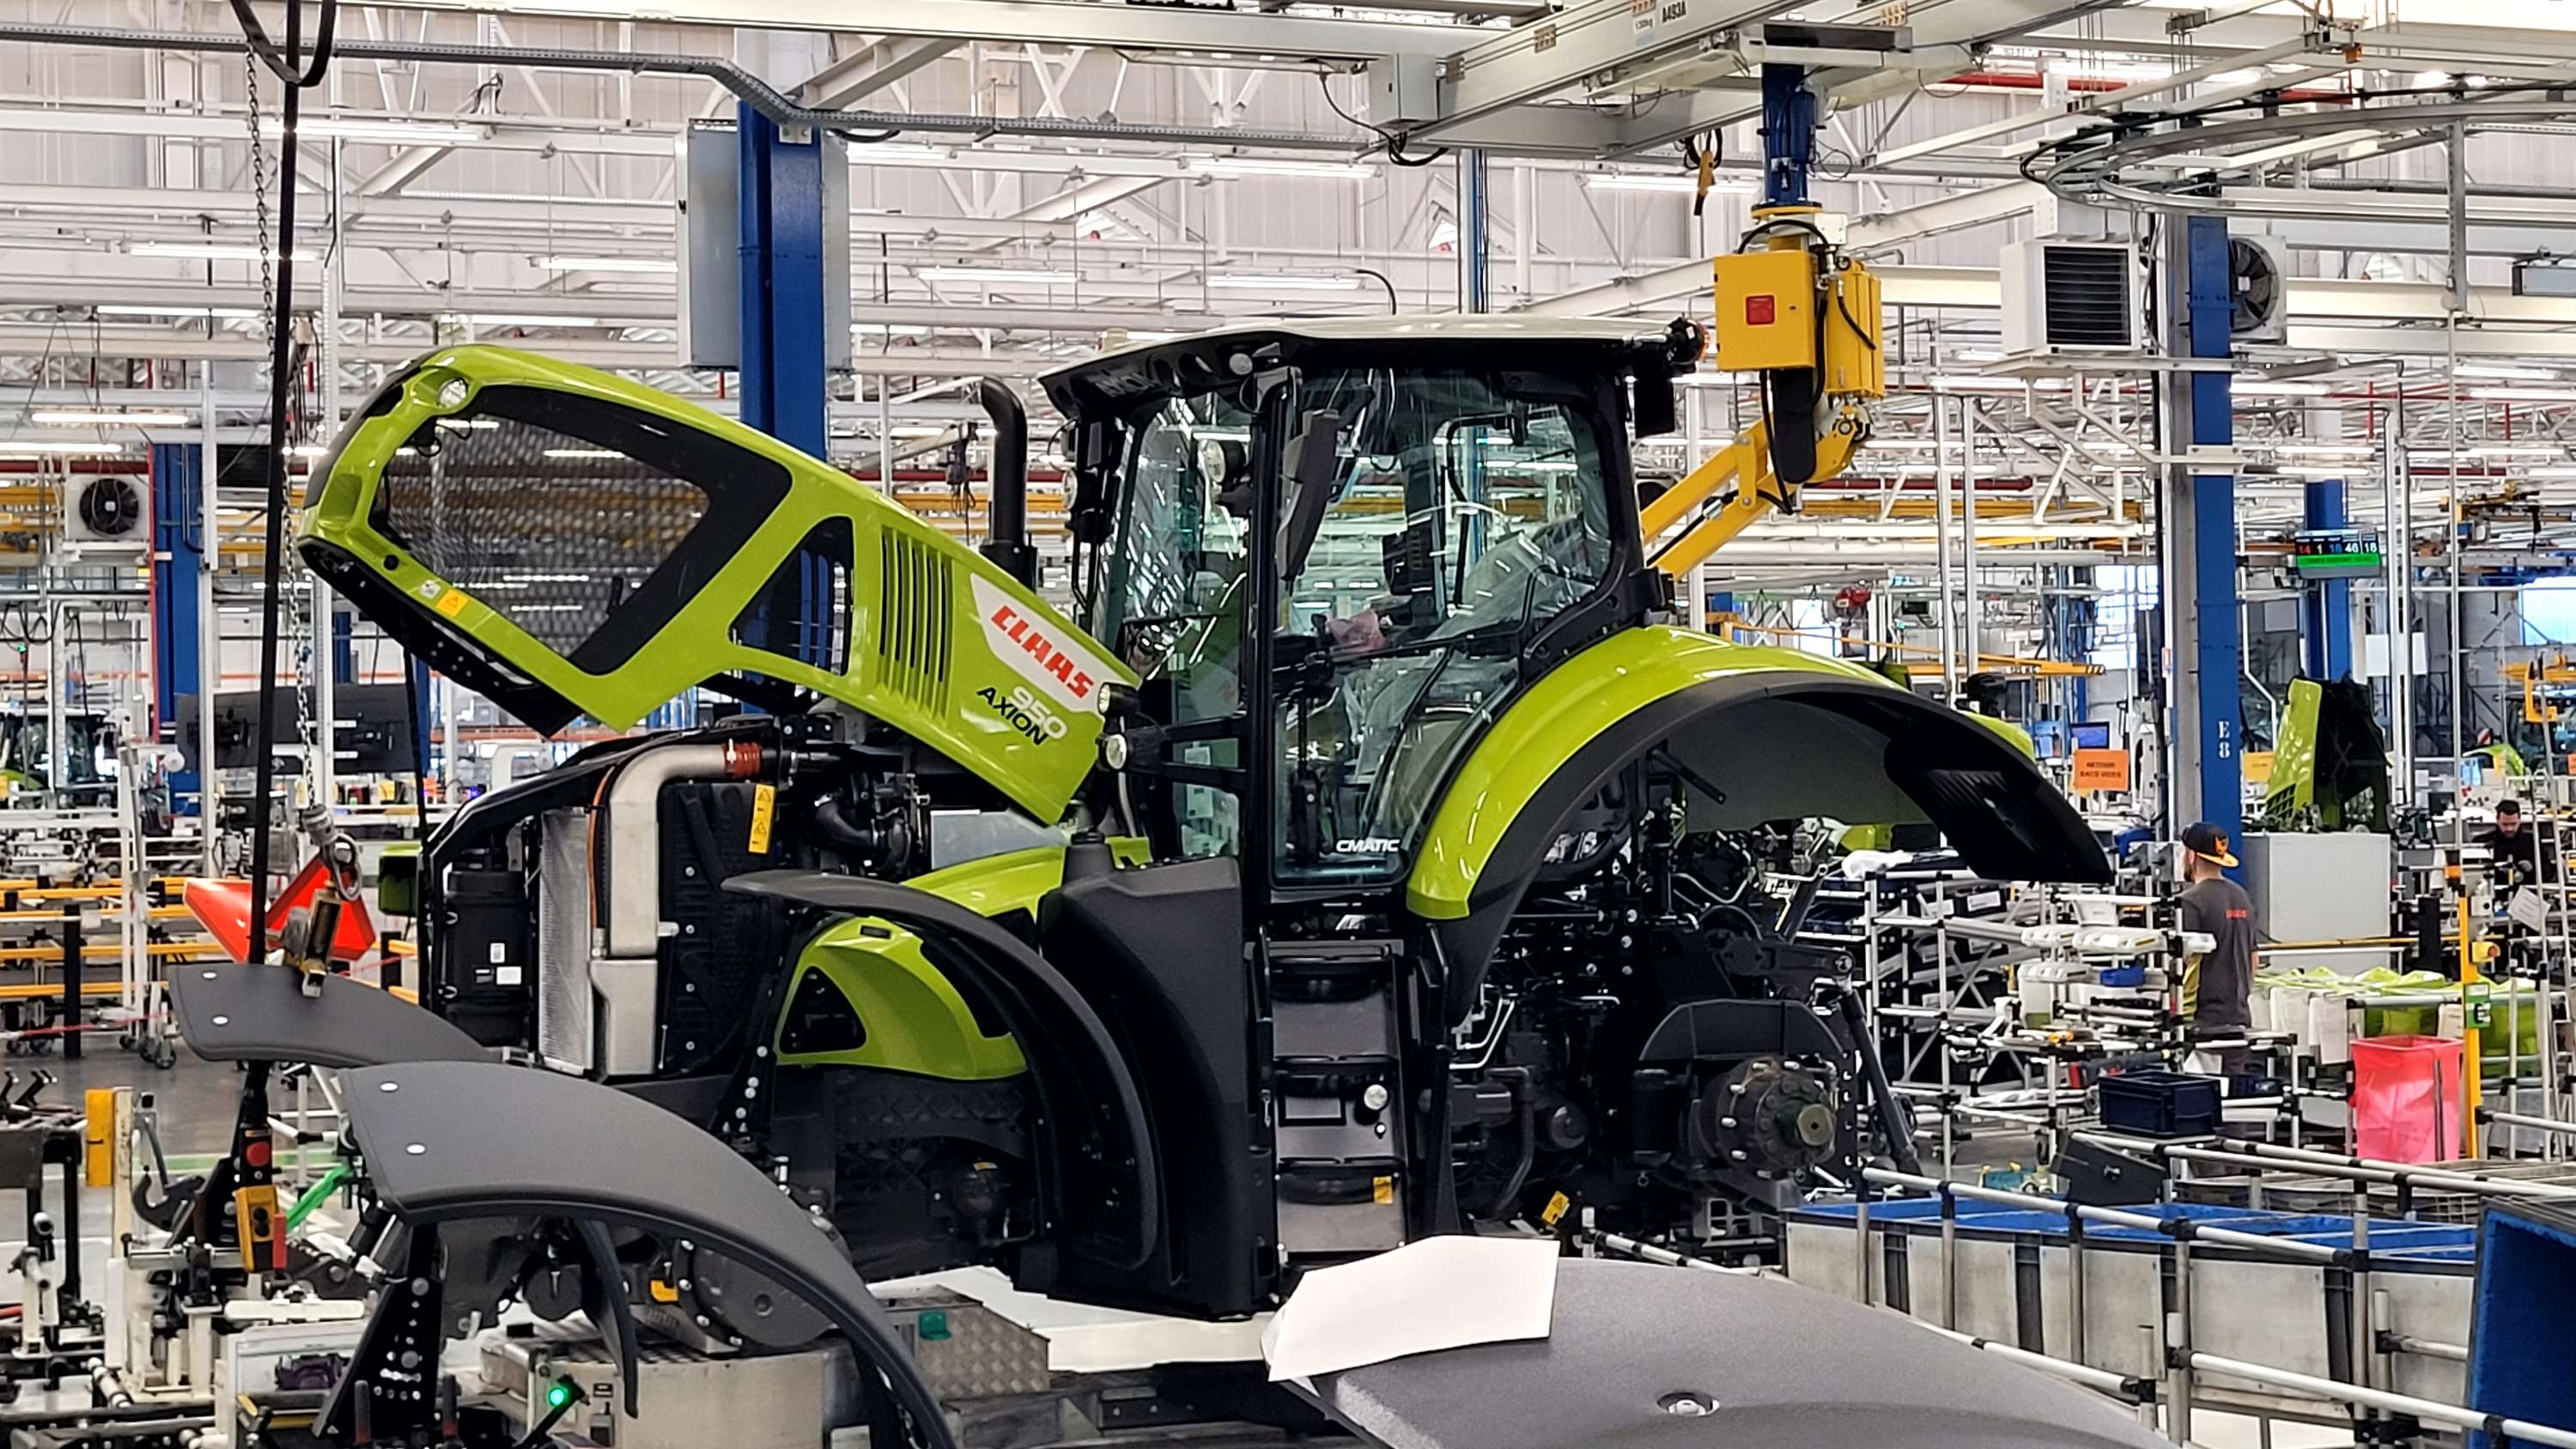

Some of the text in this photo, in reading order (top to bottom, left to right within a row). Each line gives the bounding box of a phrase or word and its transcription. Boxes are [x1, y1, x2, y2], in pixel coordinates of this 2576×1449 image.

[991, 604, 1095, 699] CLAAS
[976, 687, 1049, 746] AXION
[1008, 686, 1068, 739] 950
[1335, 839, 1400, 852] CMATIC
